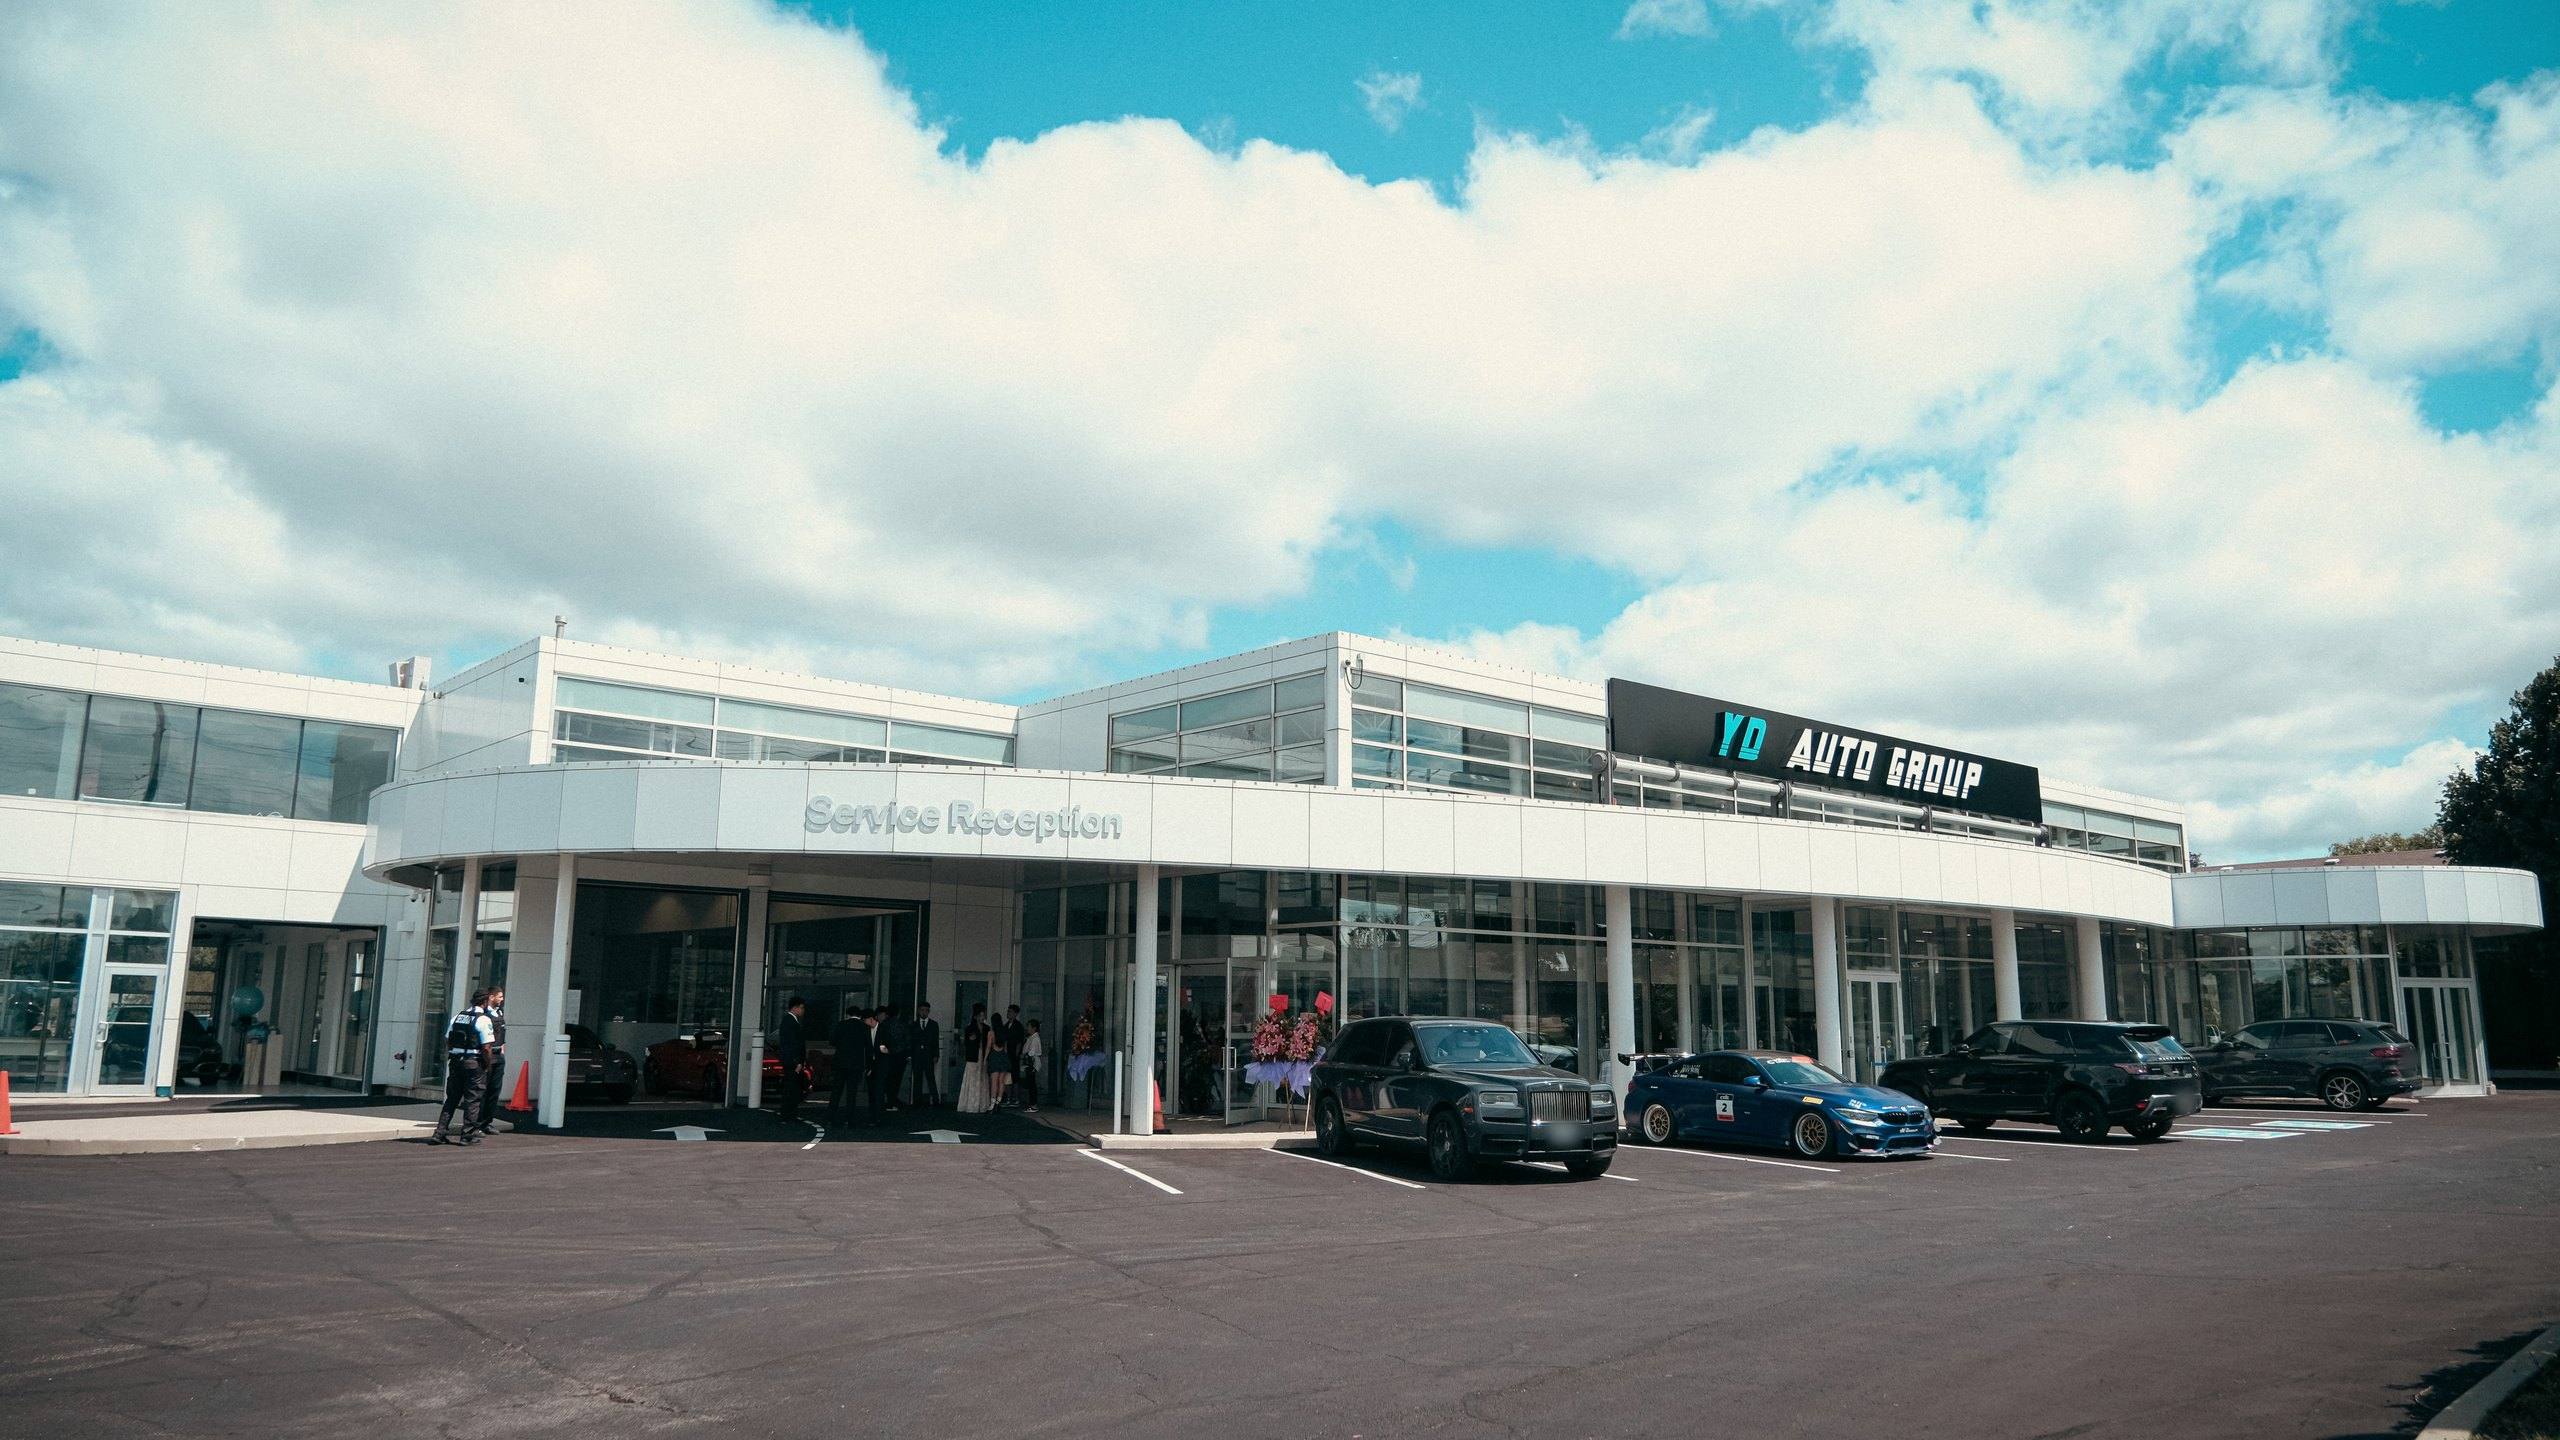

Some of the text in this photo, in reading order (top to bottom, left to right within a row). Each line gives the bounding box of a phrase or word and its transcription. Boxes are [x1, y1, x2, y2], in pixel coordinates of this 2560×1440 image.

[1785, 728, 1878, 782] AUTO
[1886, 746, 1983, 800] GROUP
[806, 795, 1123, 842] Service Reception
[1721, 1103, 1728, 1113] 2
